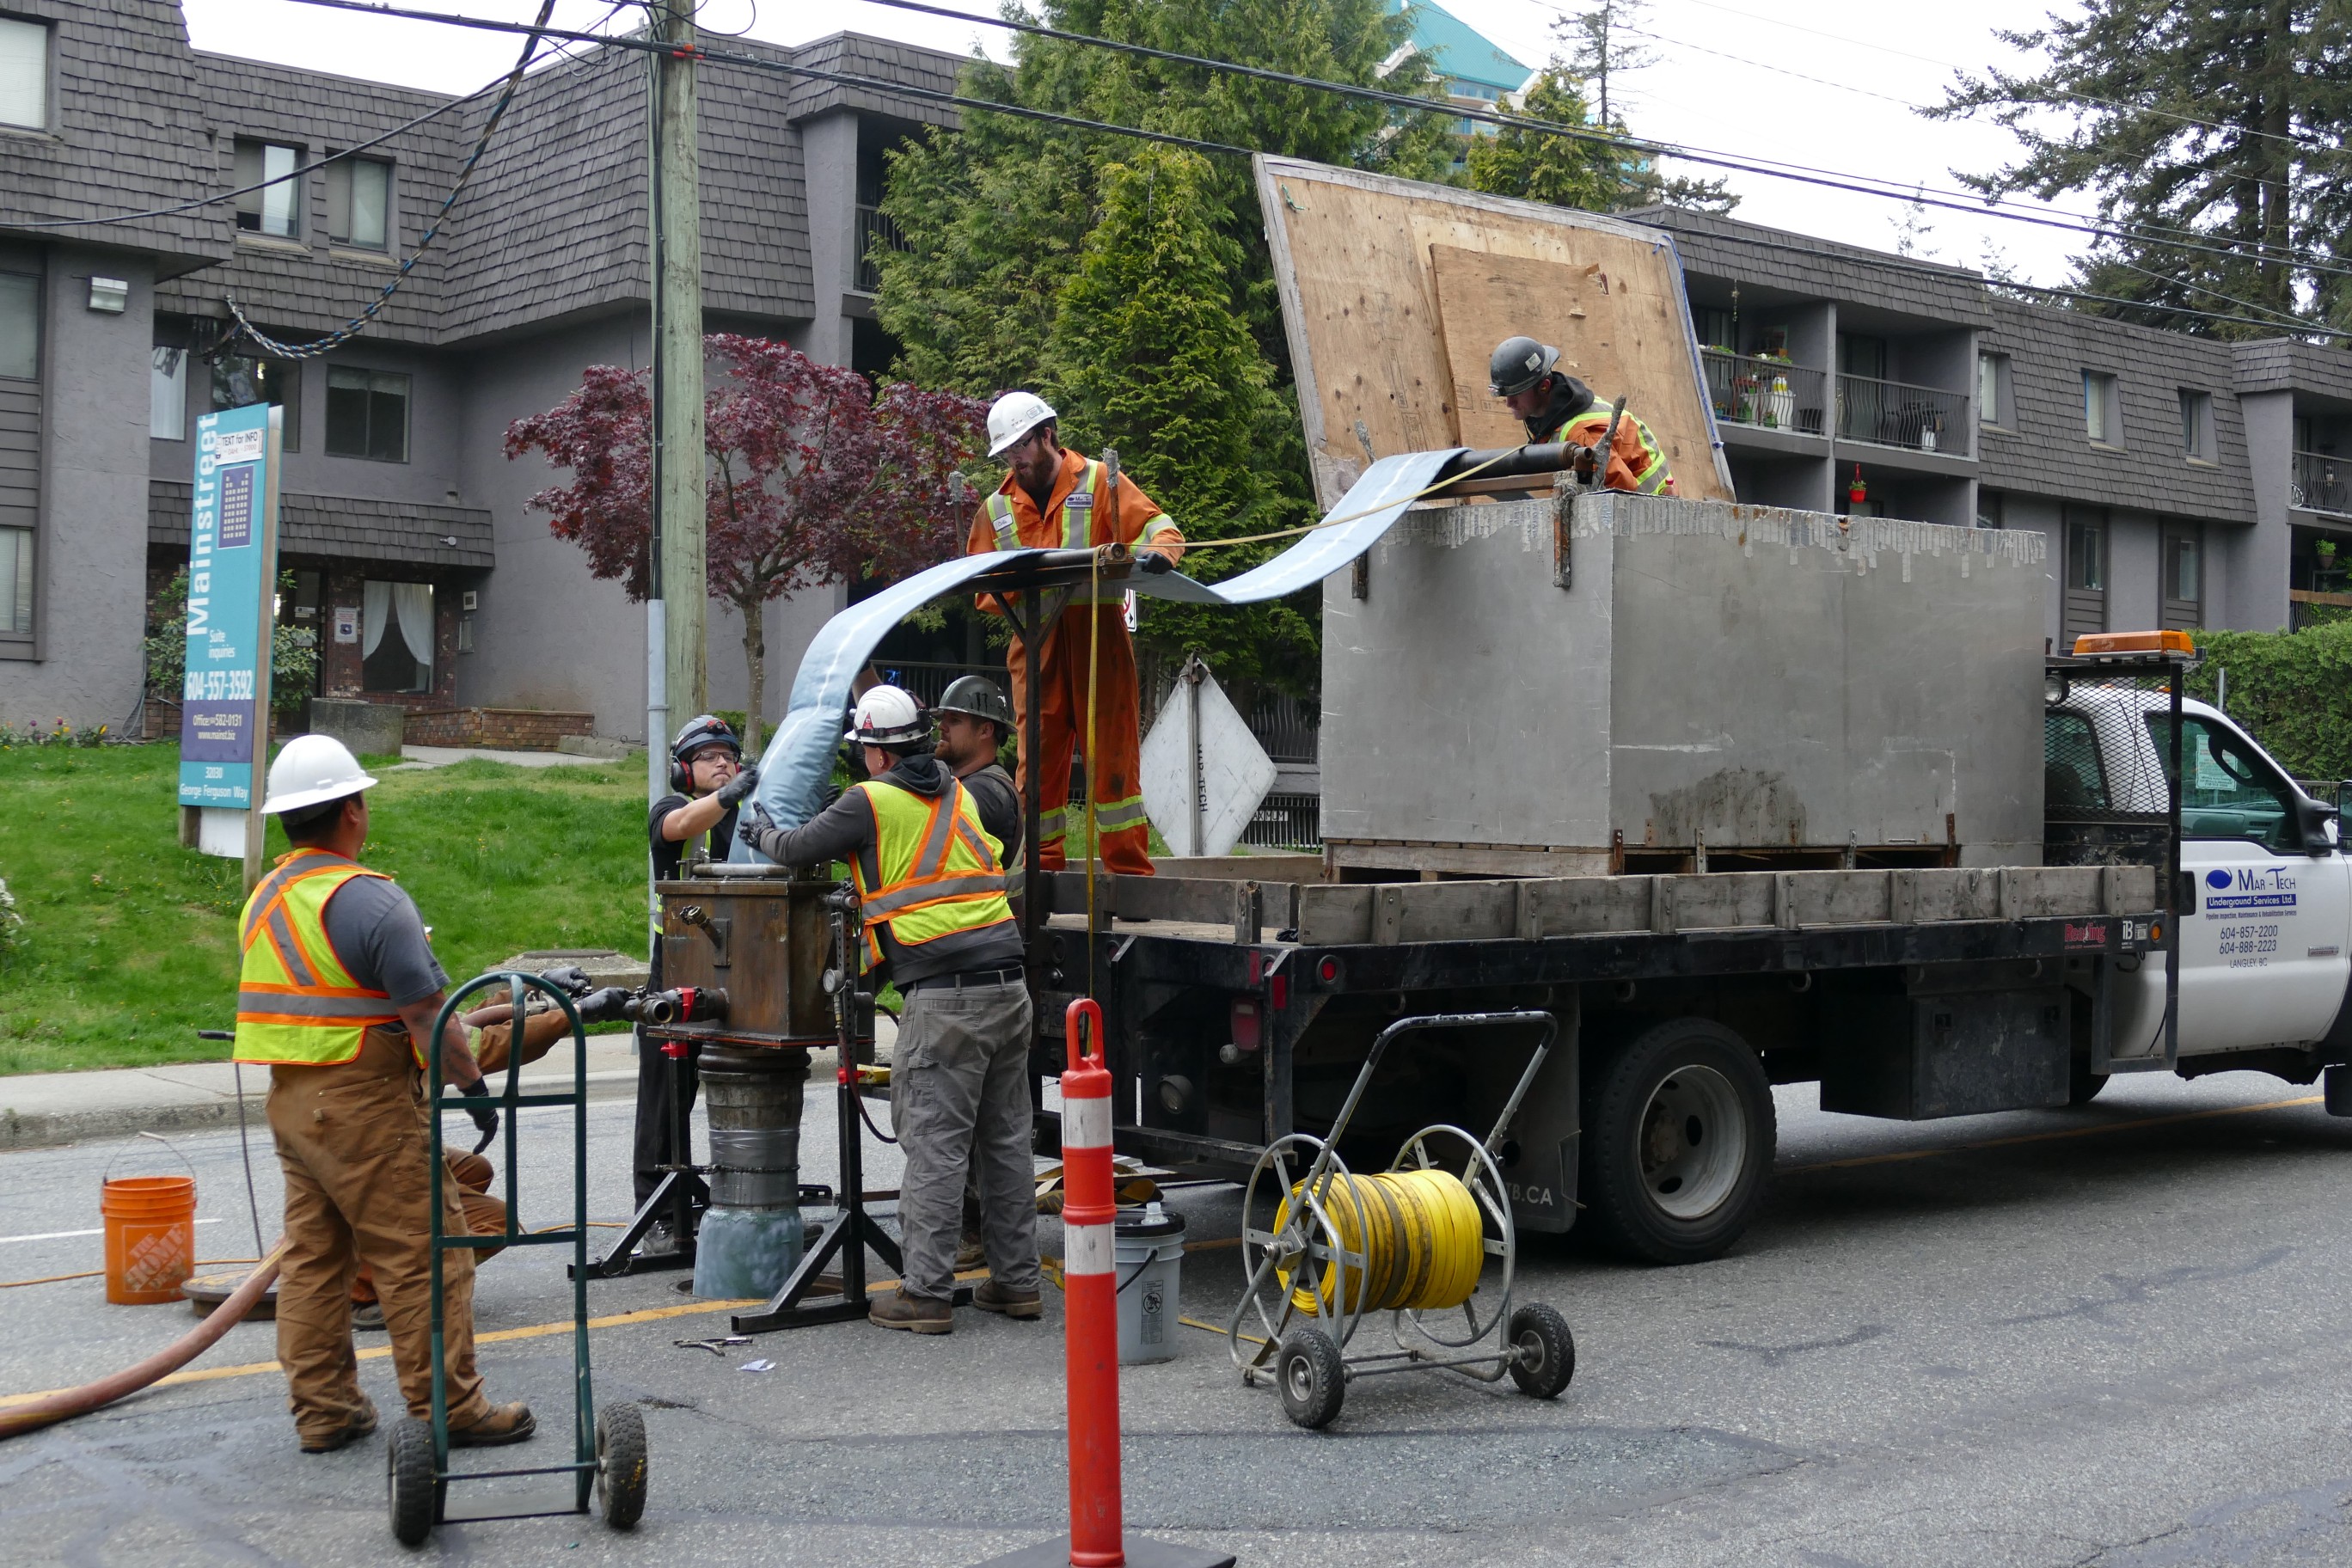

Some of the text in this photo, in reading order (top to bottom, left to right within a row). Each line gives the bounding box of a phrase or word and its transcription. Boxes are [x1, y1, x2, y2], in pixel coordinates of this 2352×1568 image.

[222, 431, 258, 446] TEXT for INFO
[187, 412, 218, 635] Mainstreet
[210, 628, 226, 643] Suite
[208, 644, 236, 662] inquiries
[187, 670, 252, 701] 604-557-3592
[180, 783, 248, 802] George Ferguson Way
[2208, 895, 2294, 908] Underground Services Ltd.
[2220, 924, 2278, 940] 604-857-2200
[2219, 939, 2277, 954] 604-888-2223
[2230, 957, 2268, 968] LANGLEY, BC
[125, 1223, 186, 1293] HOME
